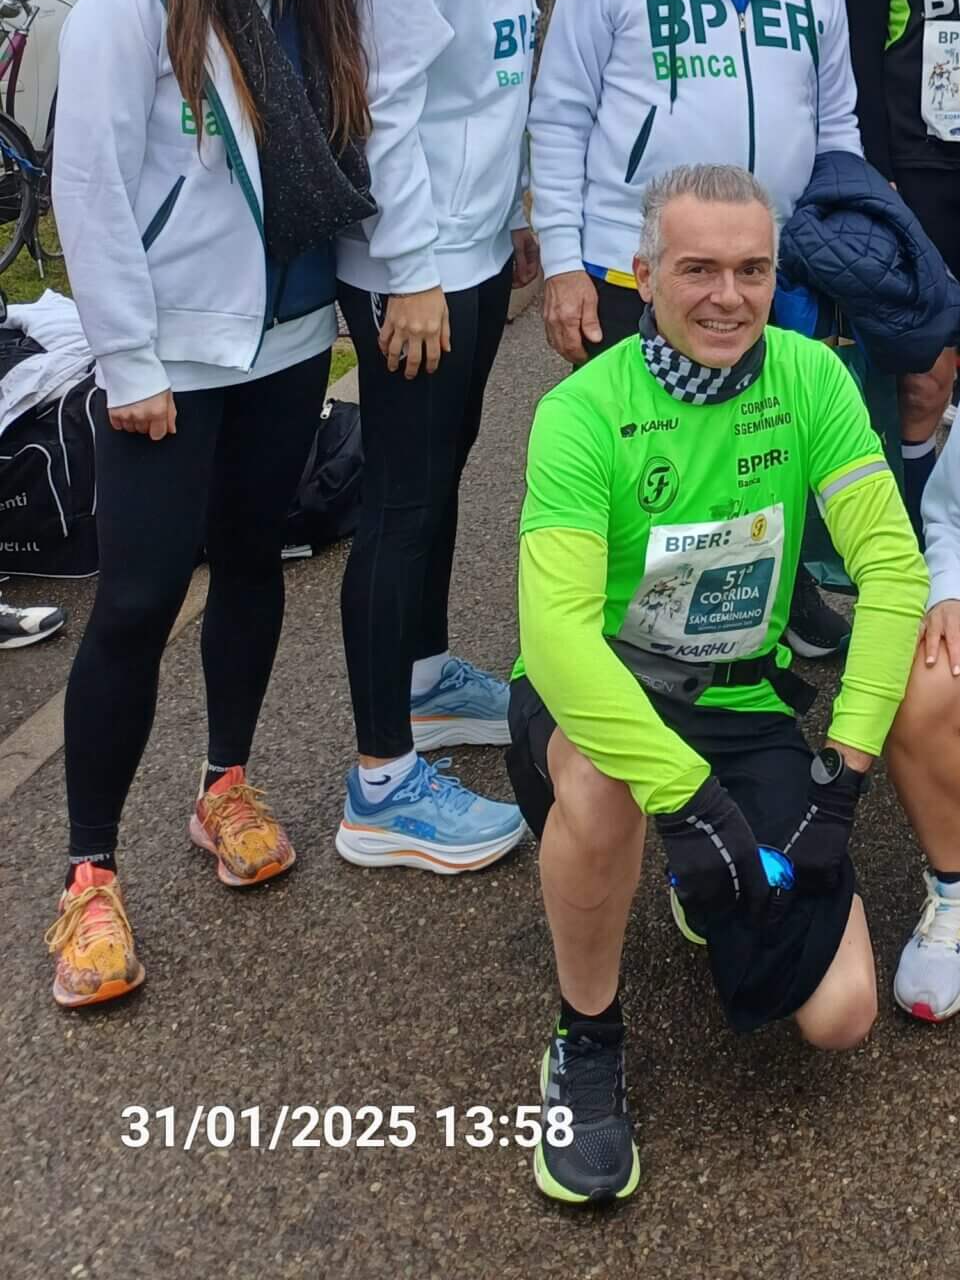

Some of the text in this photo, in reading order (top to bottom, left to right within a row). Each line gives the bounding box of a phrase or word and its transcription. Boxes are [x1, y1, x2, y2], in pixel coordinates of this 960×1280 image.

[652, 51, 738, 80] Banca
[738, 449, 789, 475] BPER:
[665, 530, 732, 552] BPER:
[700, 586, 760, 604] CORRIDA
[722, 602, 734, 612] DI
[688, 608, 762, 625] SAN GEMINIANO
[675, 641, 737, 657] KARHU
